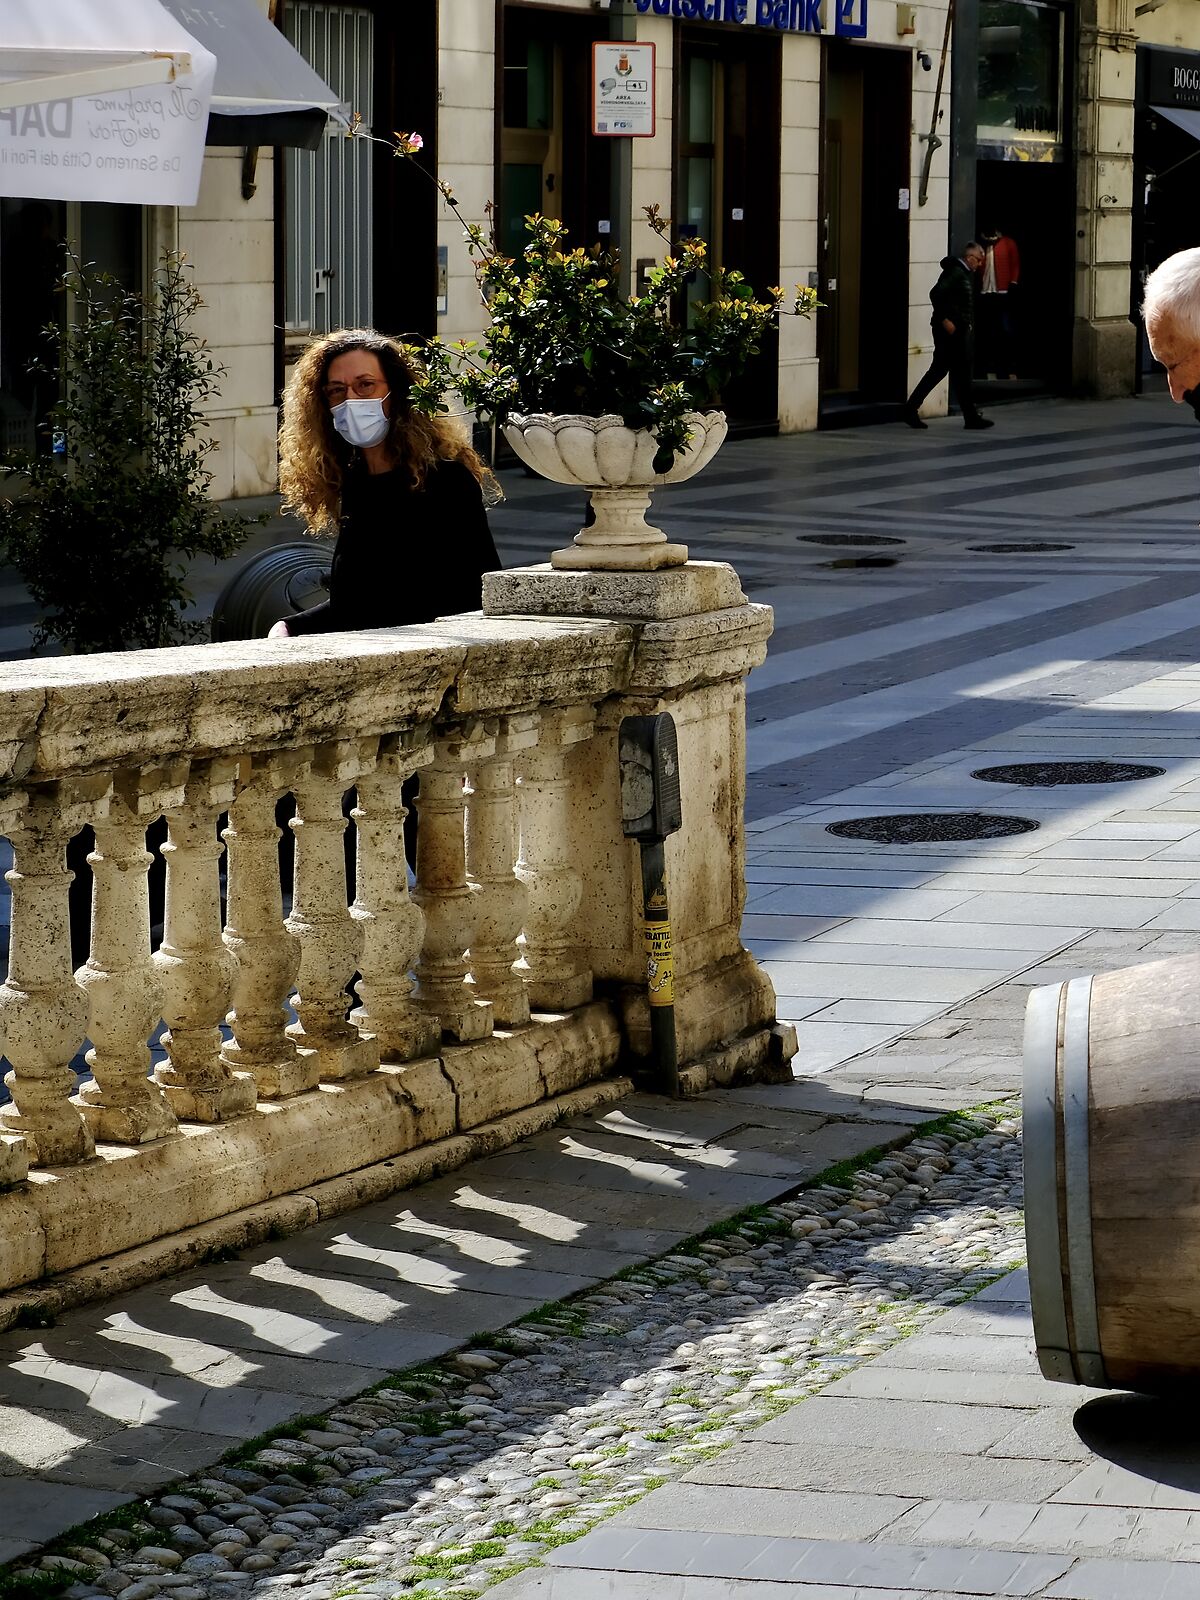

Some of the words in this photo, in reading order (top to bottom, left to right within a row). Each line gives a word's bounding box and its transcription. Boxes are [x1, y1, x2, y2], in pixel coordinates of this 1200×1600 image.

[756, 0, 822, 33] Bank
[1175, 93, 1200, 102] MILANO
[652, 941, 662, 950] IN
